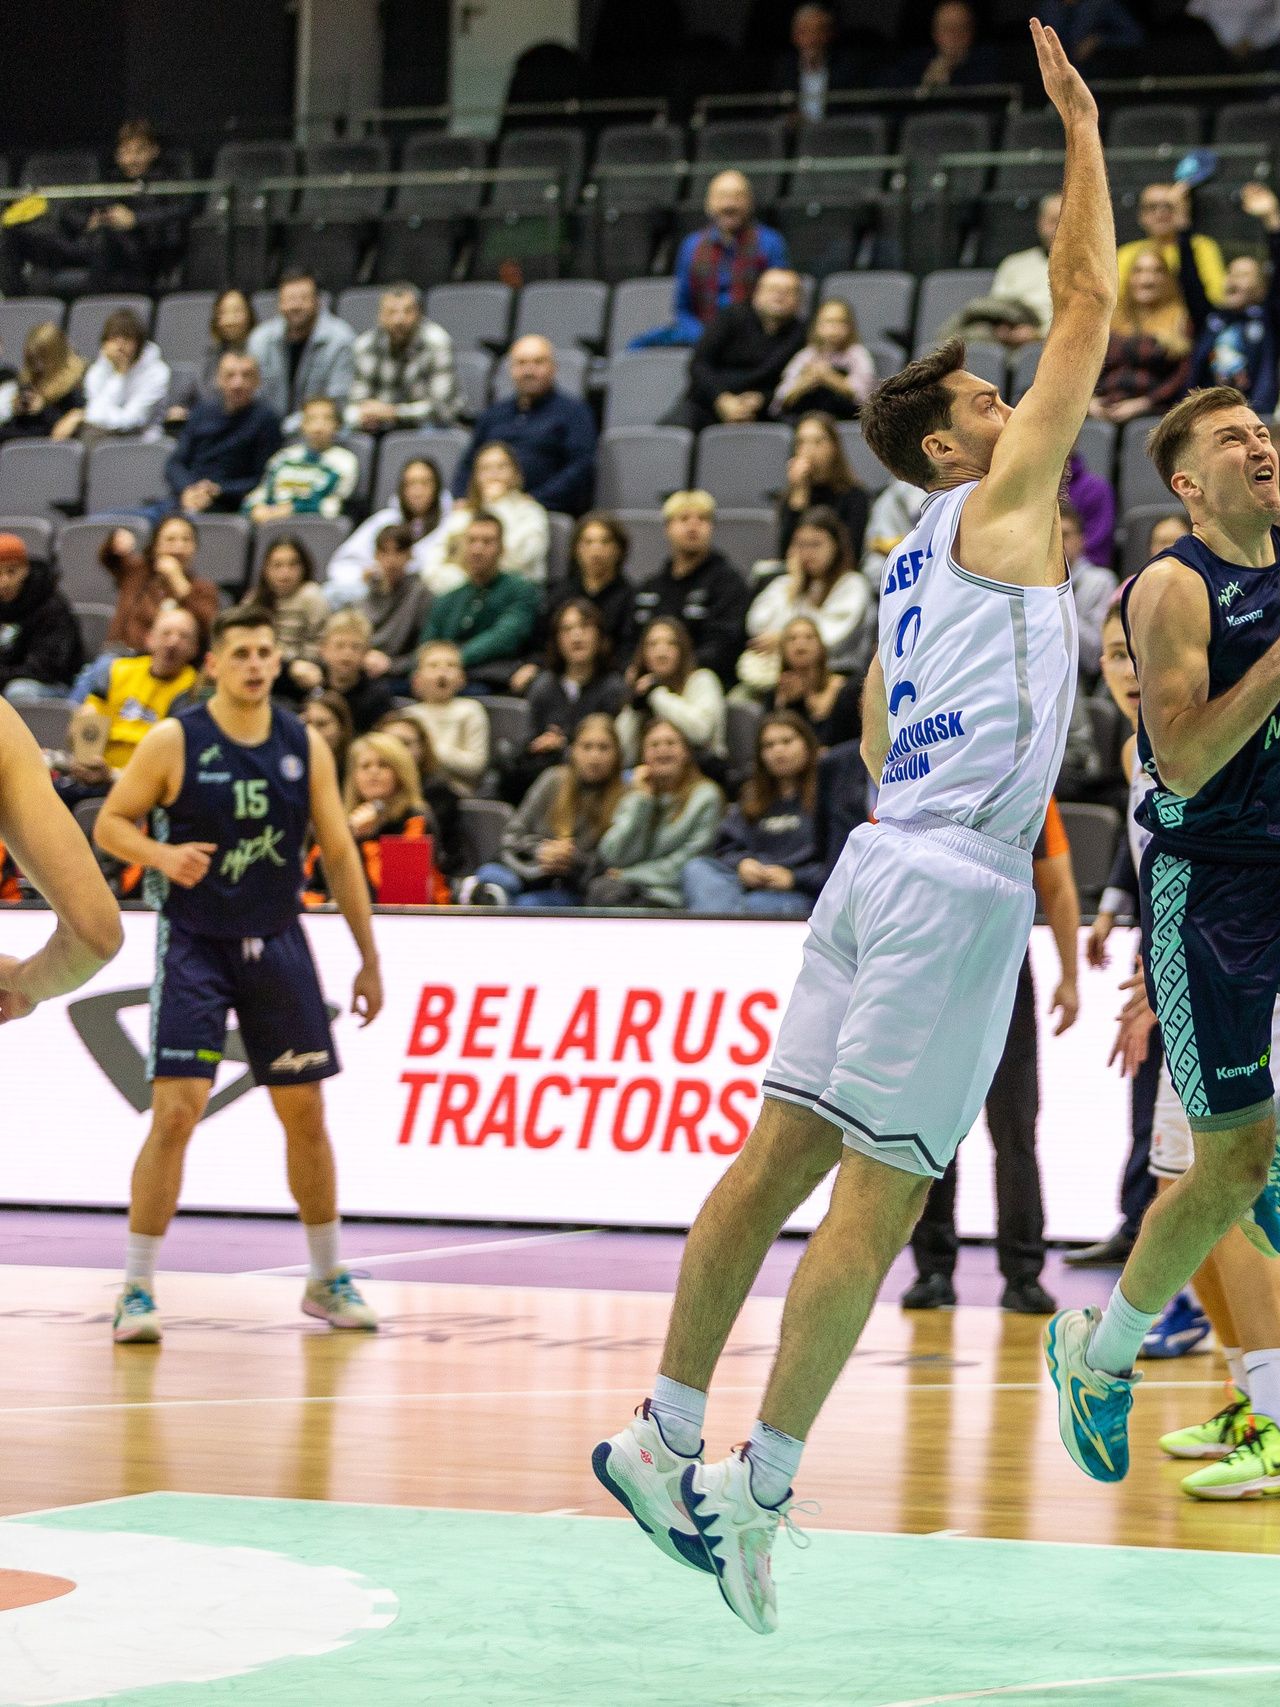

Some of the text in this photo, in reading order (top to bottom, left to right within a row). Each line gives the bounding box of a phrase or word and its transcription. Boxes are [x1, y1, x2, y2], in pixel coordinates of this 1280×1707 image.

[1226, 609, 1264, 628] Kempa
[233, 779, 269, 819] 15
[406, 984, 779, 1066] BELARUS
[1216, 1061, 1259, 1080] Kempa
[398, 1071, 758, 1156] TRACTORS
